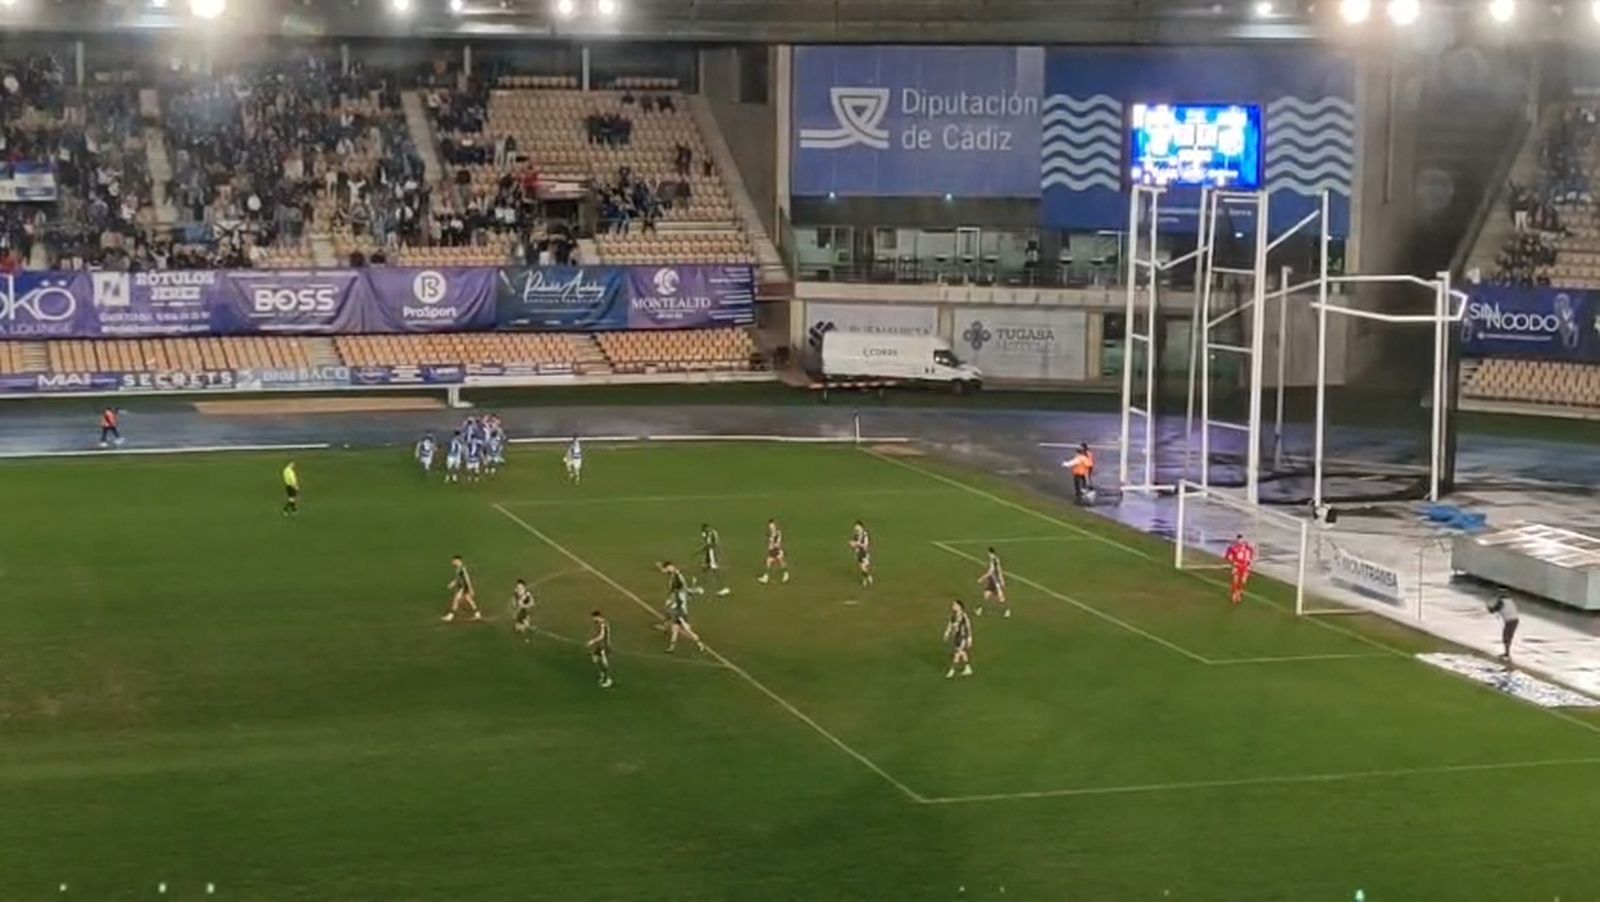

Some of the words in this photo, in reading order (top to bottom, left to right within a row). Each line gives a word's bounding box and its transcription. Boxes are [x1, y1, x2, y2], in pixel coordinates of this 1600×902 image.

[902, 87, 1038, 120] Diputación
[902, 124, 932, 151] de
[943, 123, 1013, 152] Cádiz
[254, 289, 335, 312] BOSS
[630, 297, 712, 310] MONTEALTO
[402, 306, 457, 320] ProSport
[995, 328, 1055, 342] TUGASA
[123, 370, 233, 387] SECRETS
